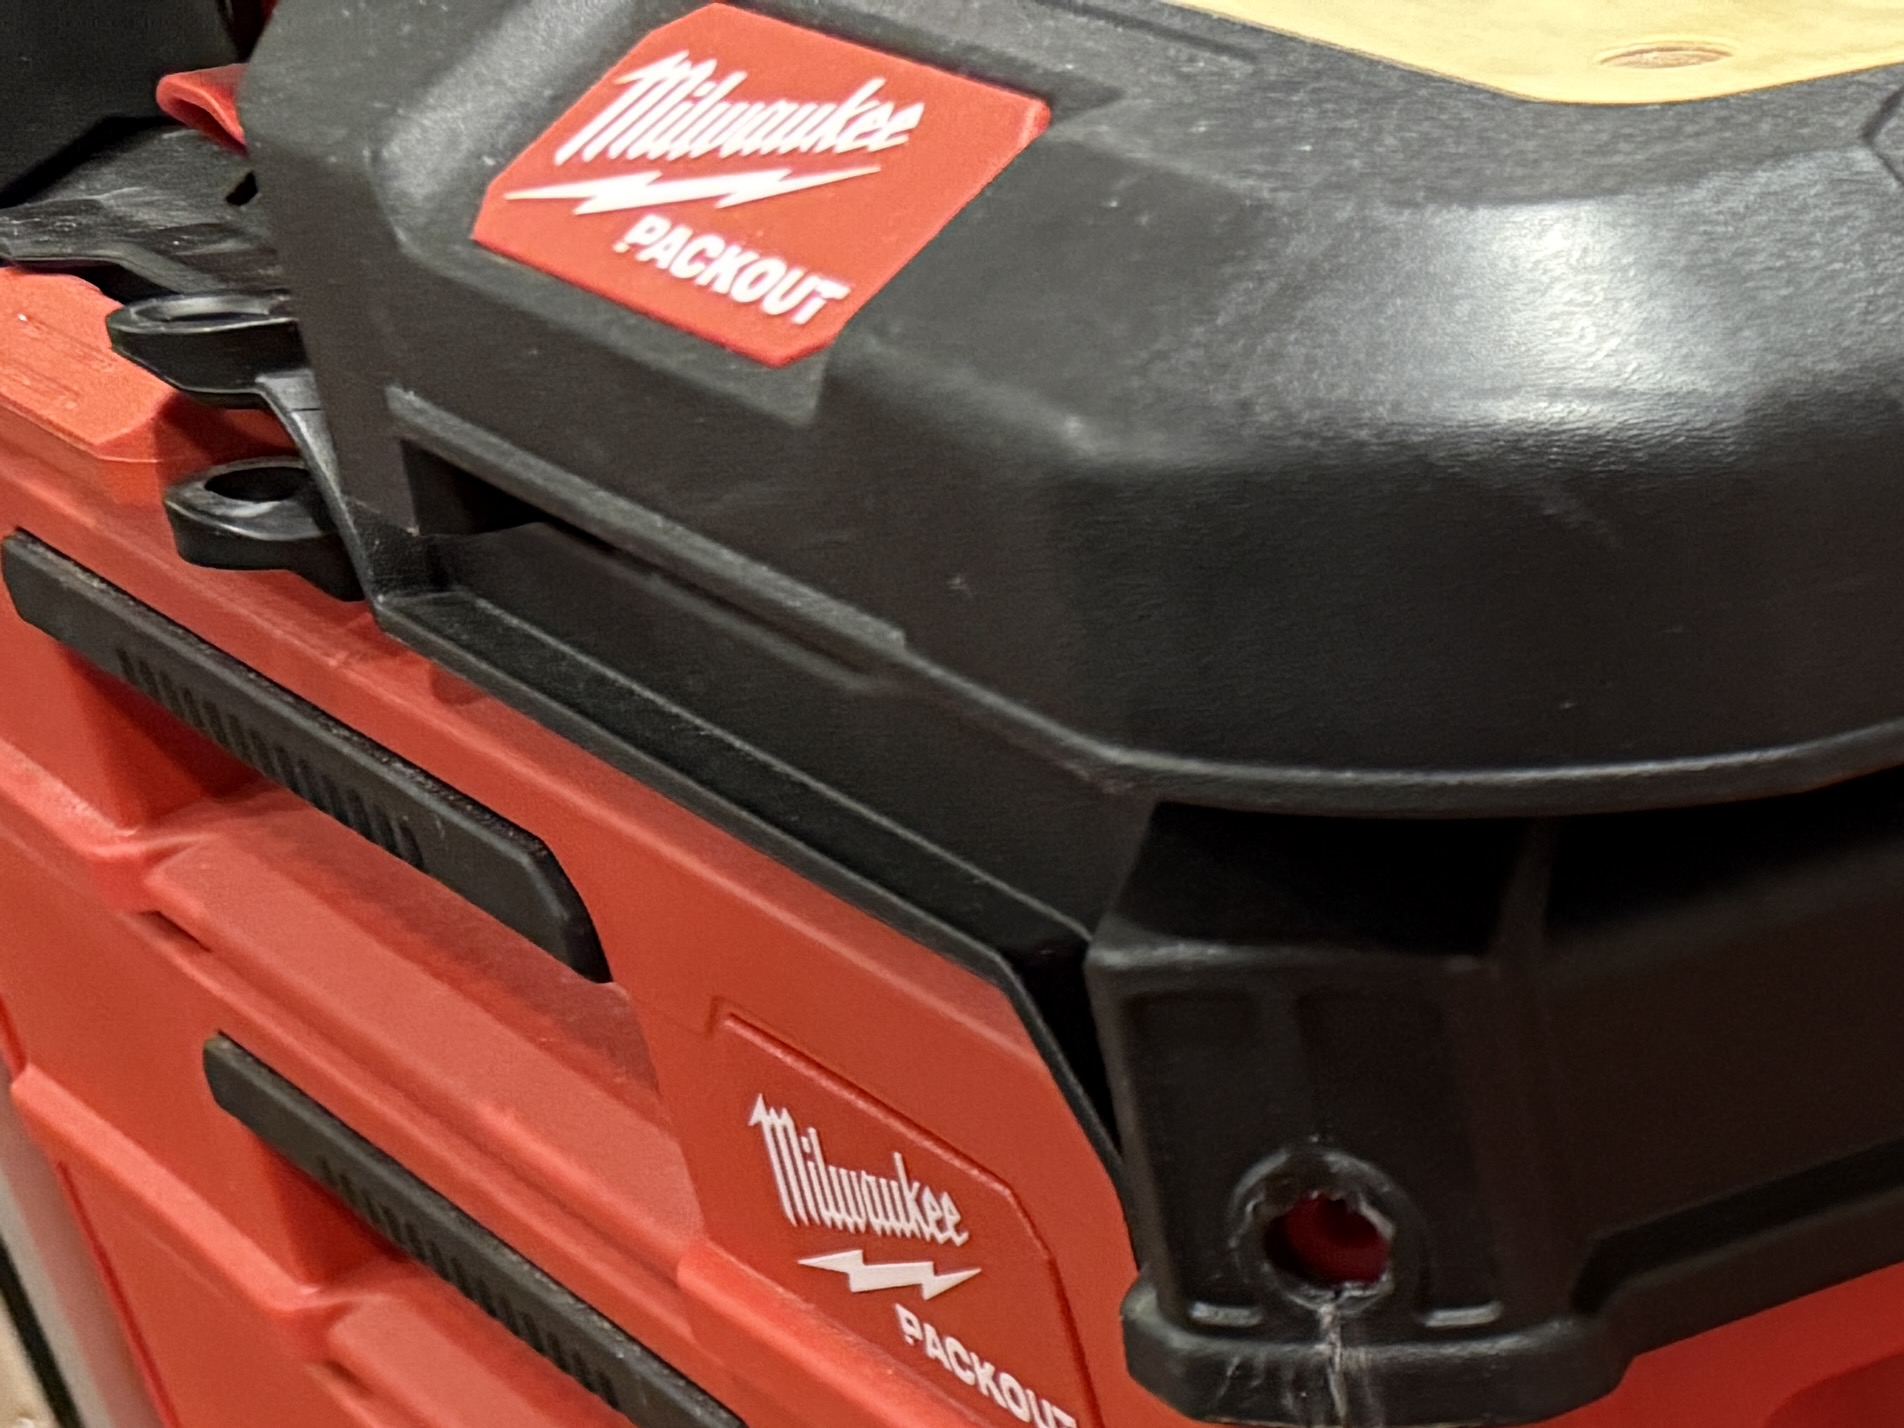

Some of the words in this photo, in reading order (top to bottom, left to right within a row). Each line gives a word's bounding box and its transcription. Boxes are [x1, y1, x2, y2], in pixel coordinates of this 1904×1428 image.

[553, 49, 925, 166] Milwaukee
[612, 213, 850, 325] PACKOUT
[748, 1092, 970, 1247] Milwaukee
